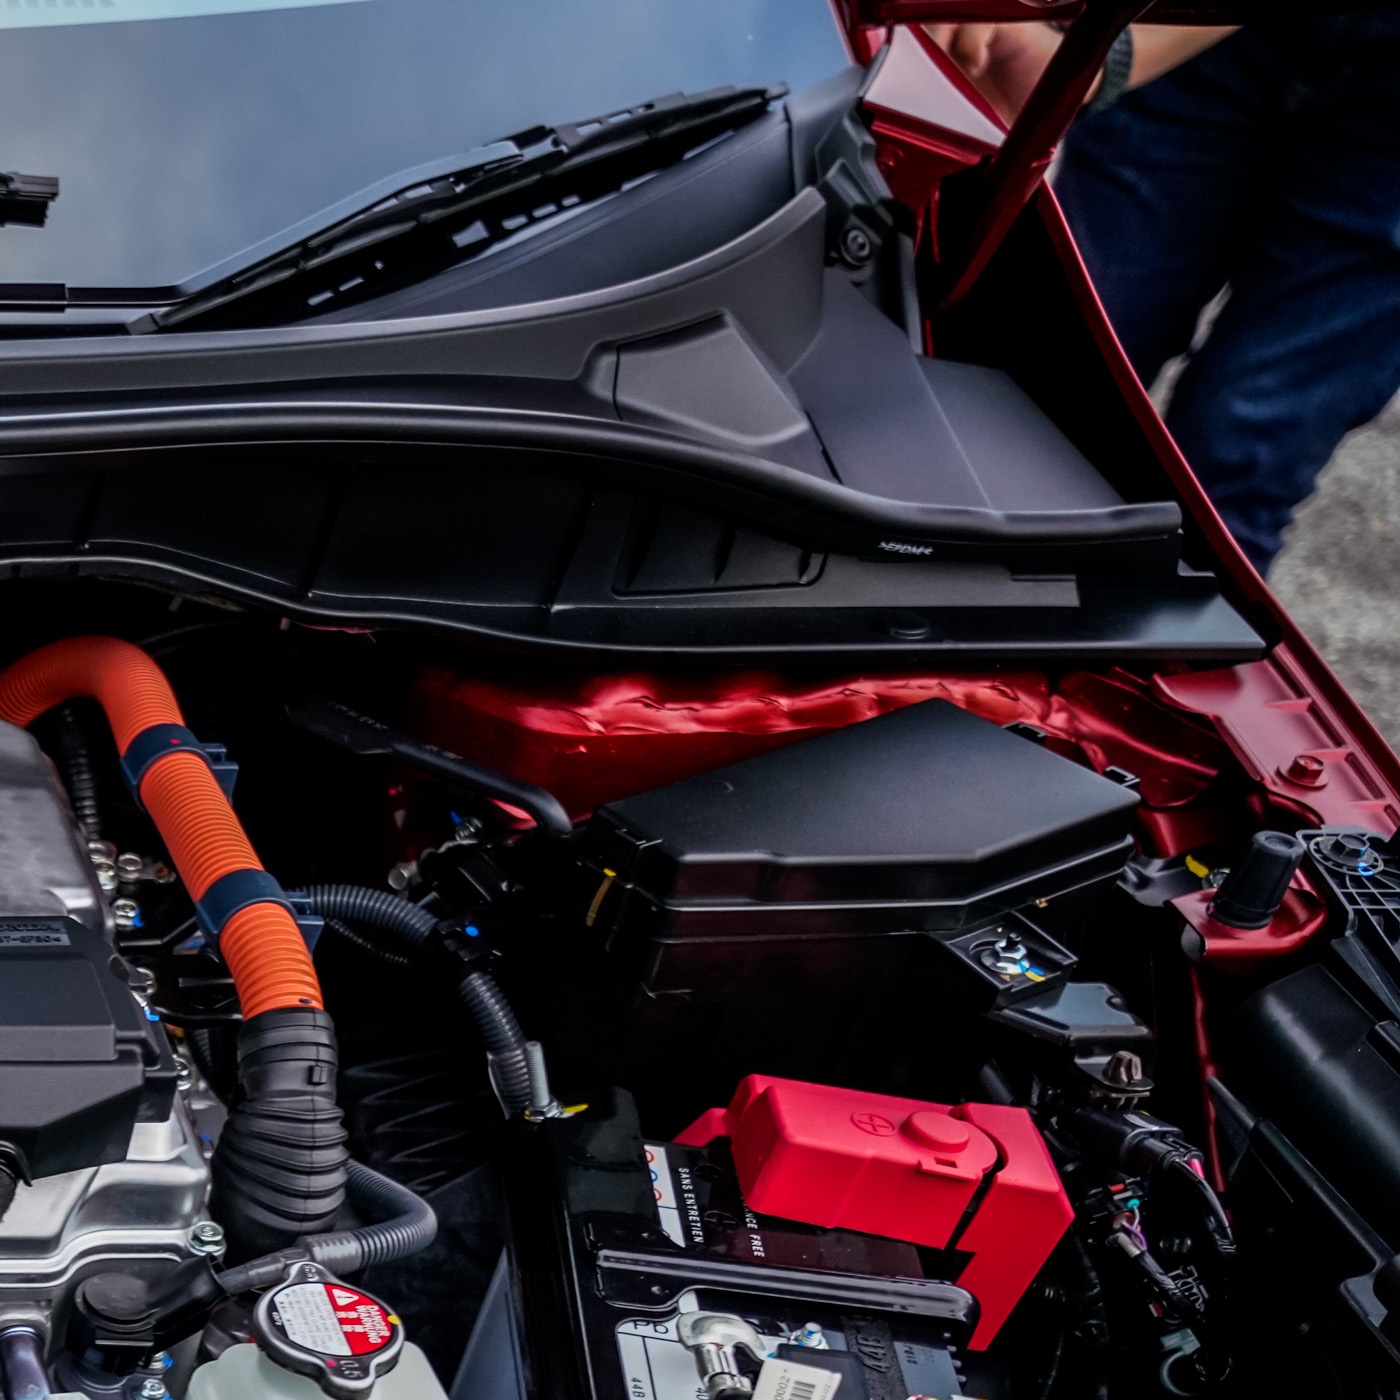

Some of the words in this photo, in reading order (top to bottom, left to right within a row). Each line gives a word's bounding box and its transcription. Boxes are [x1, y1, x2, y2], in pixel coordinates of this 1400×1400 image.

[678, 1167, 693, 1190] SANS
[684, 1193, 704, 1243] ENTRETIEN
[749, 1234, 765, 1257] FREE
